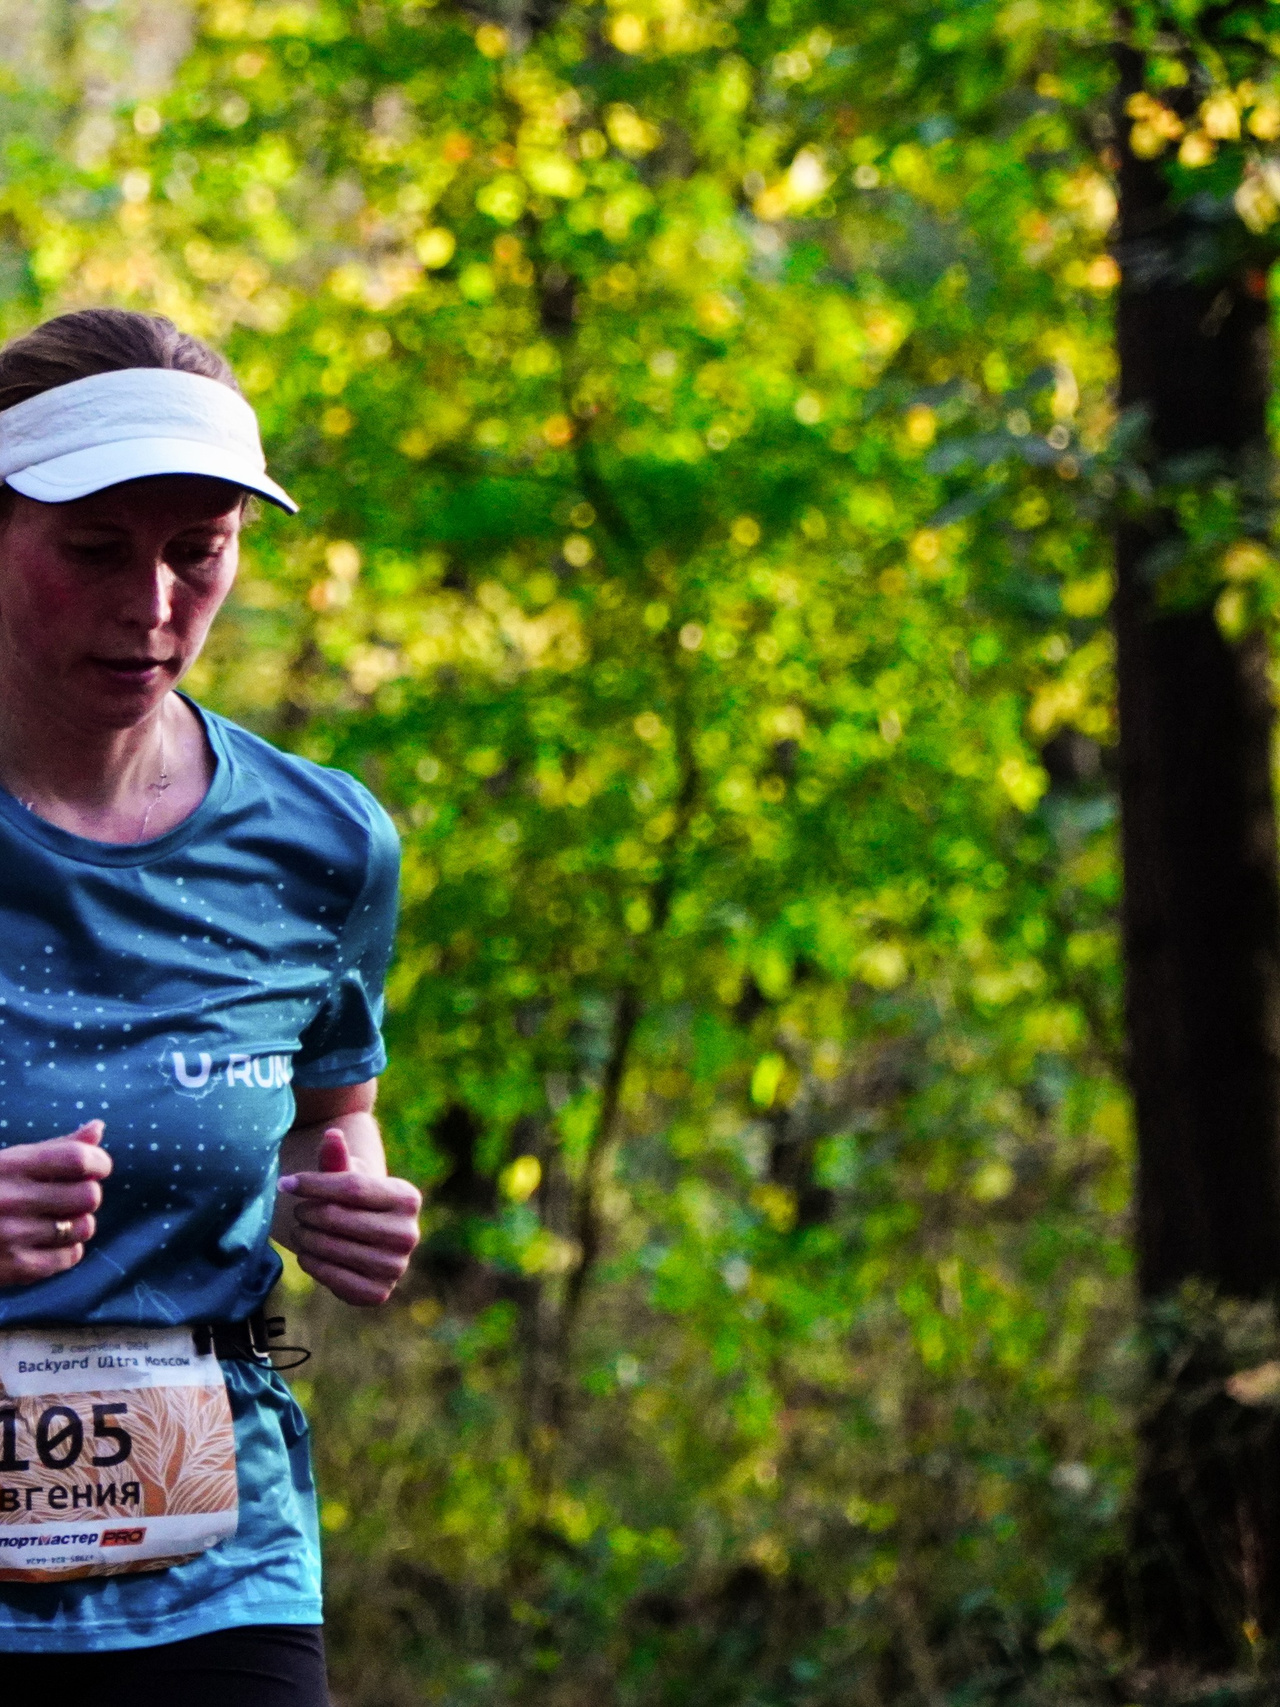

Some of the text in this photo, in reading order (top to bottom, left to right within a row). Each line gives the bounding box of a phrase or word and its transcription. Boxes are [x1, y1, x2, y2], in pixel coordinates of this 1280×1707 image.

[172, 1052, 212, 1088] U
[18, 1355, 190, 1374] Backyard Ultra Moscow
[101, 1530, 144, 1544] PRO
